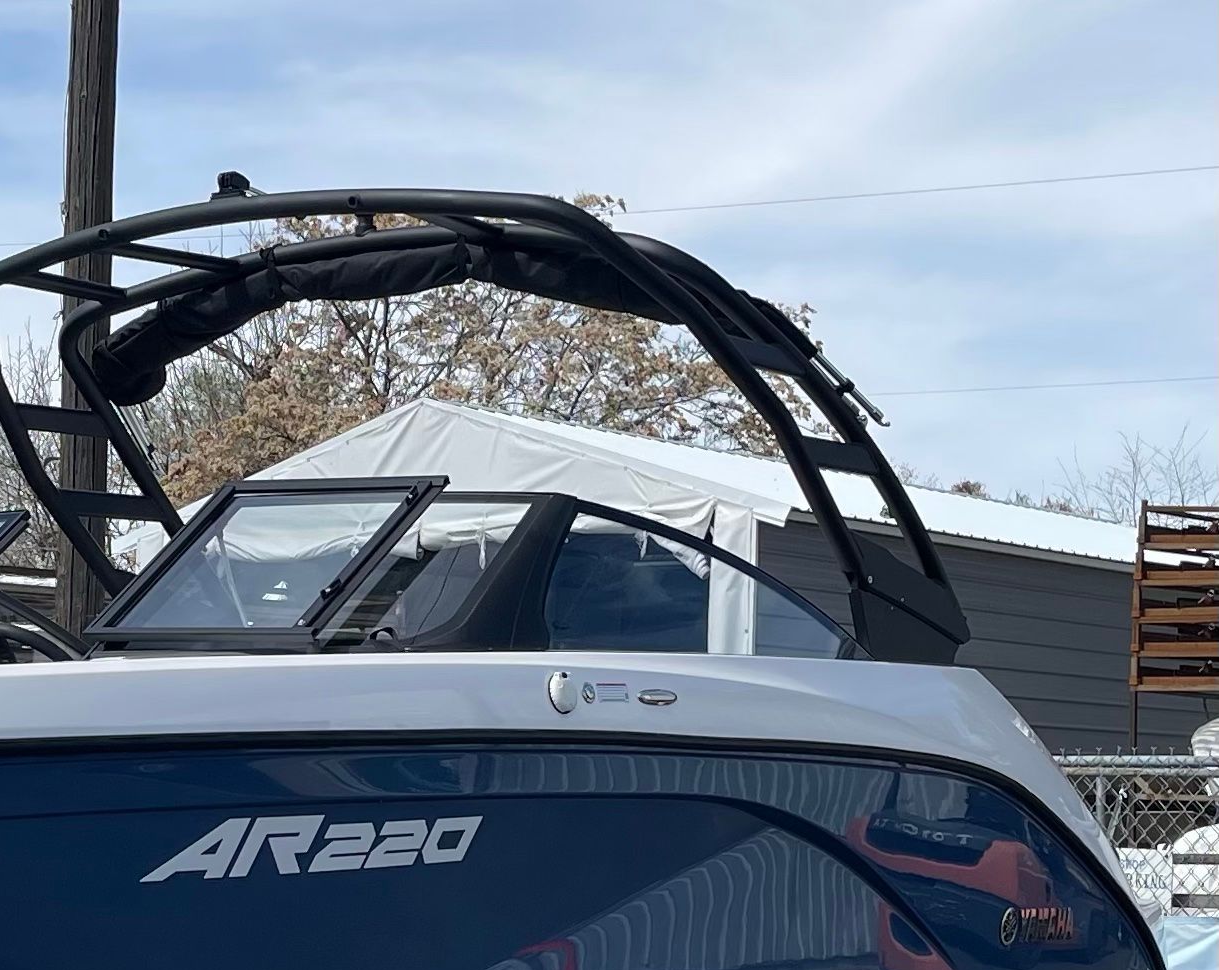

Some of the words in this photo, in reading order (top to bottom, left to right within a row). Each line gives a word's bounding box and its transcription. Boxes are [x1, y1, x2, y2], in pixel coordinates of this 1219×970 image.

[140, 814, 483, 883] AR220
[1125, 872, 1167, 890] RKING
[1019, 906, 1074, 943] YAMAHA
